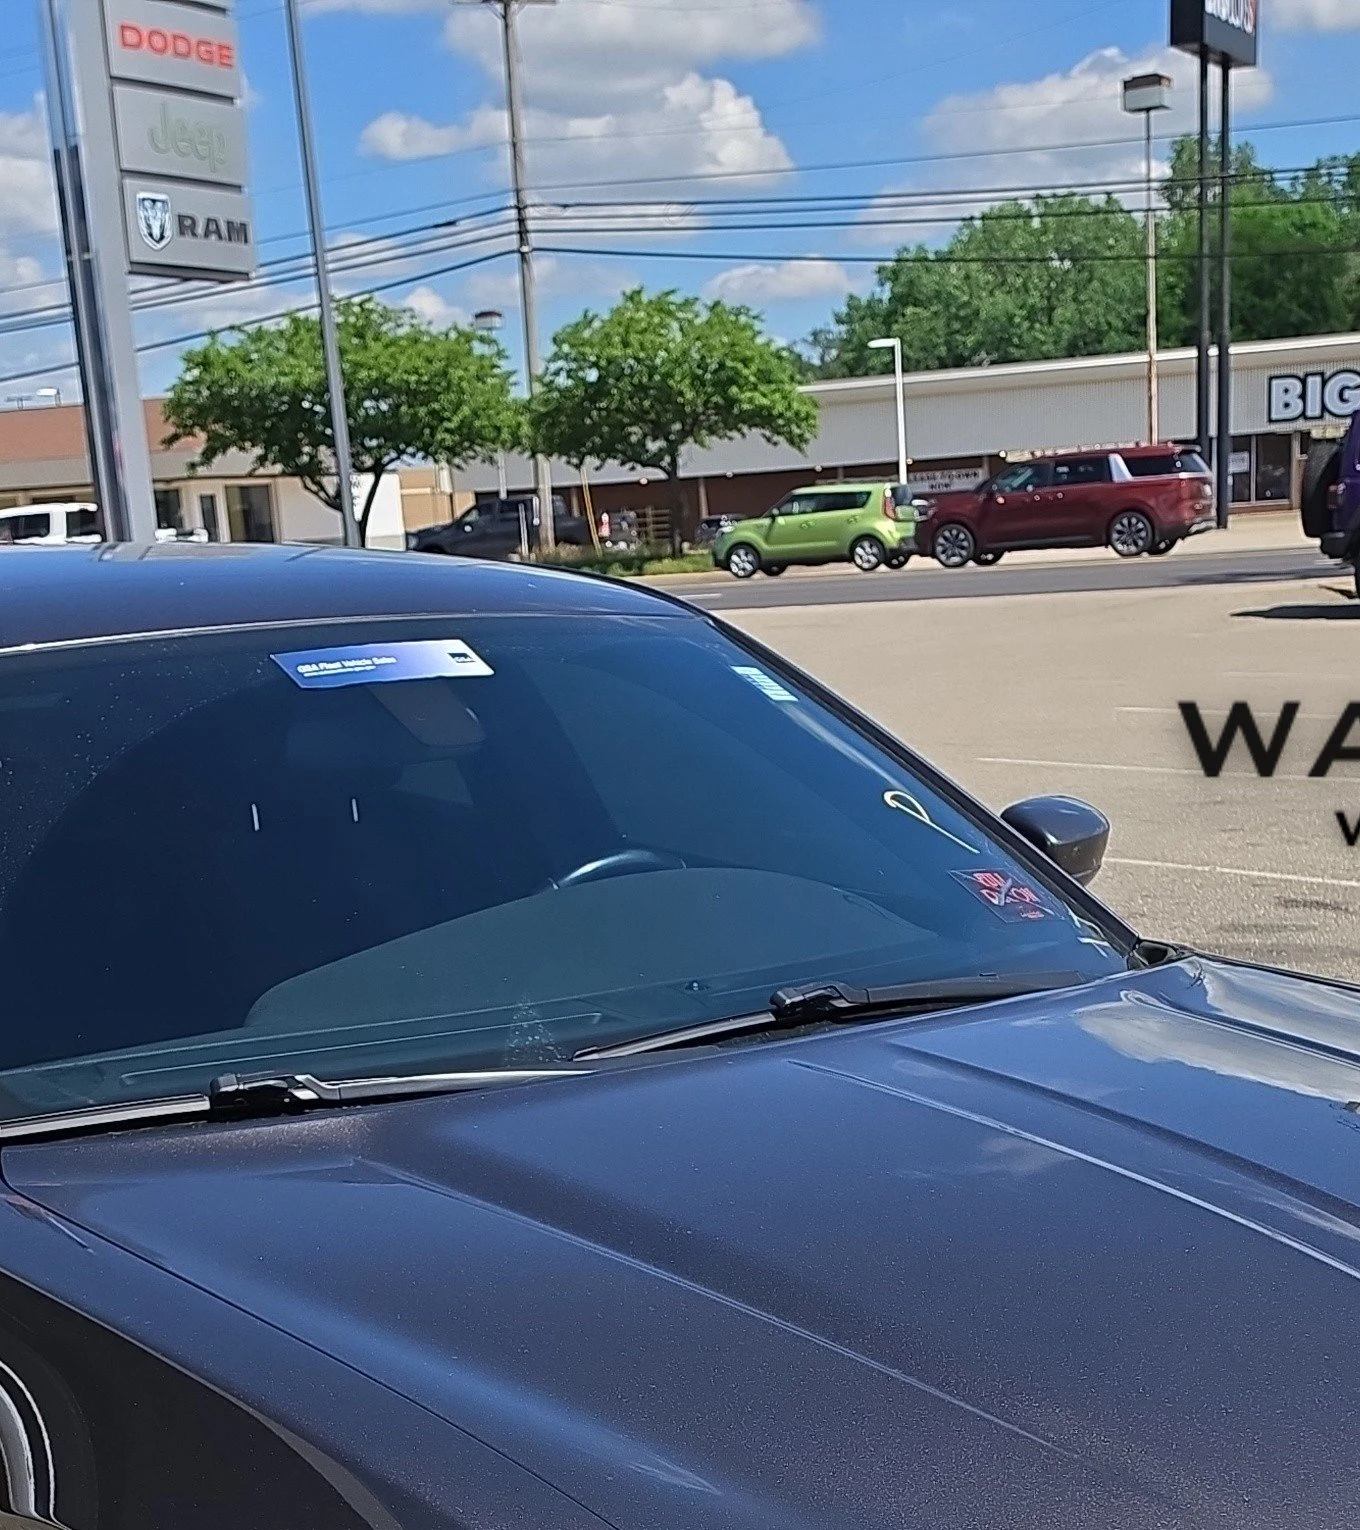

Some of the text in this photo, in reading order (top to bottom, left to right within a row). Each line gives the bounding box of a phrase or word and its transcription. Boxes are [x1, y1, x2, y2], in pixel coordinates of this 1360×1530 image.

[119, 23, 235, 69] DODGE
[147, 100, 227, 173] Jeep
[177, 214, 249, 244] RAM
